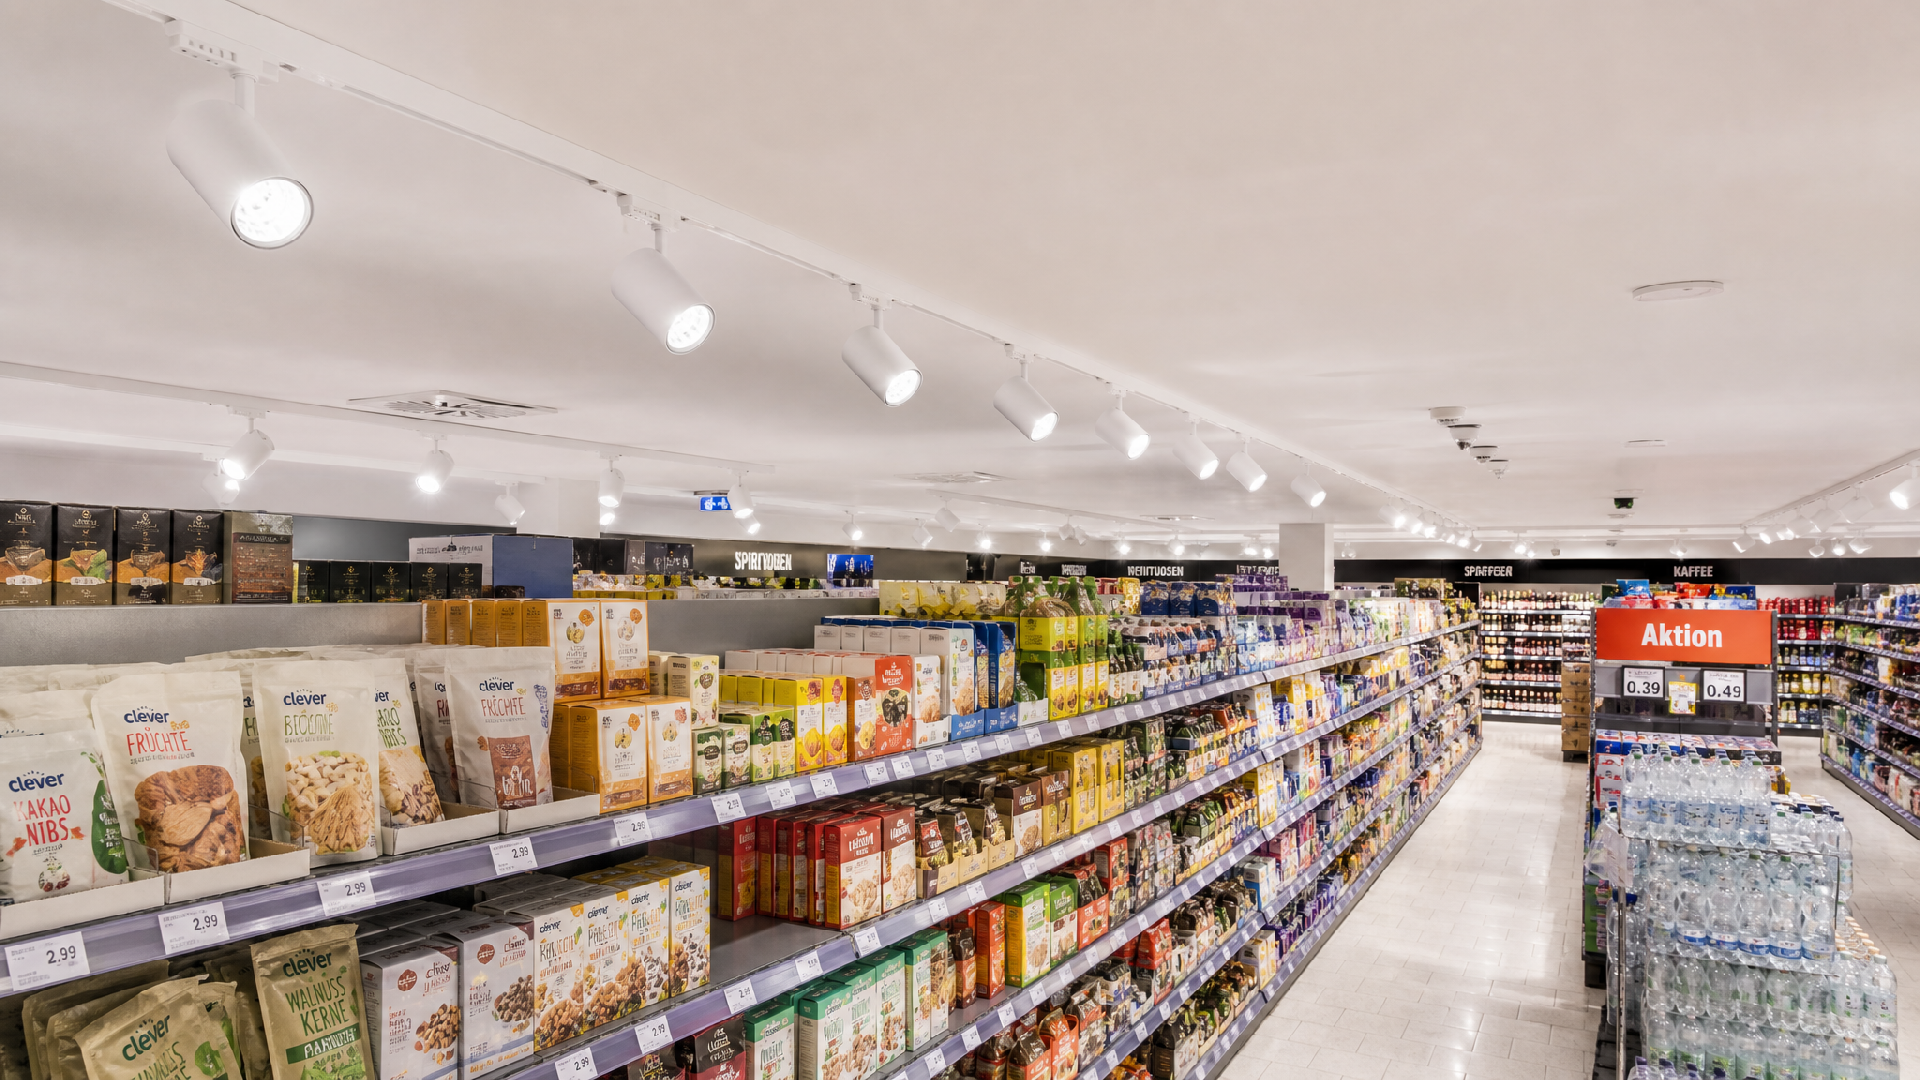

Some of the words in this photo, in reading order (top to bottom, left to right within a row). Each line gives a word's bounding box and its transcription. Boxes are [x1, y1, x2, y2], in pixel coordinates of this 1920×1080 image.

[1673, 565, 1714, 578] KAFFEE
[1641, 622, 1723, 648] Aktion
[478, 679, 515, 692] clever
[1626, 679, 1661, 696] 0.39
[1706, 681, 1742, 699] 0.49
[283, 691, 327, 707] clever
[123, 708, 170, 724] clever
[8, 771, 65, 793] clever
[13, 794, 72, 821] KAKAO
[25, 817, 70, 847] NIBS
[344, 881, 367, 897] 2.99
[192, 914, 219, 932] 2.99
[46, 945, 77, 965] 2.99
[282, 950, 333, 978] clever
[285, 976, 347, 1014] WALNUSS
[300, 999, 350, 1037] KERNE
[121, 1014, 171, 1062] clever
[573, 1056, 590, 1071] 2.99
